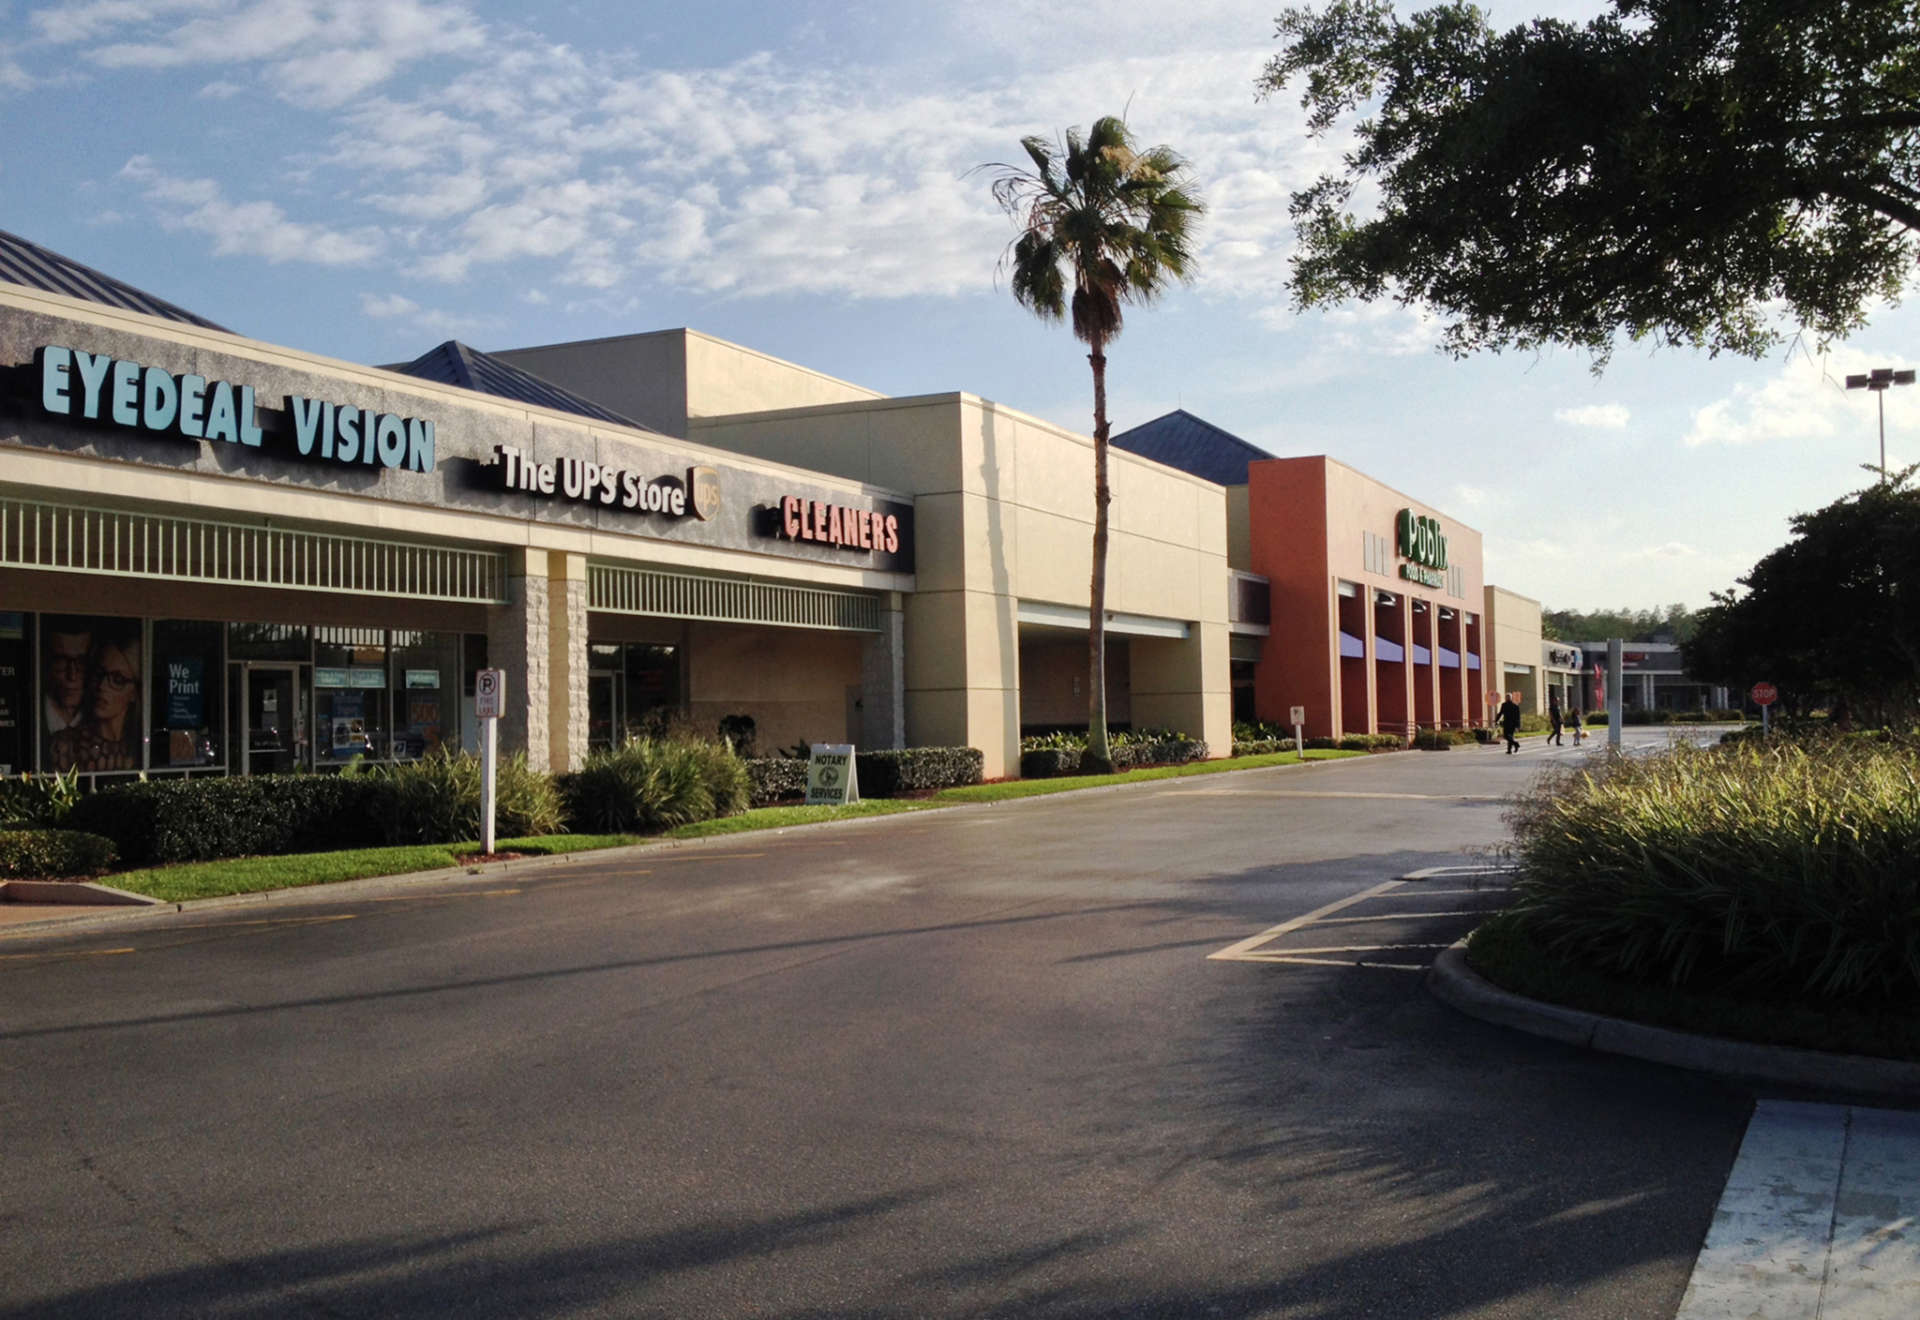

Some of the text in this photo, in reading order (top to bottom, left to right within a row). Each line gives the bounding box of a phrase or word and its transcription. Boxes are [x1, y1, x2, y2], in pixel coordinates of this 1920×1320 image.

[42, 345, 436, 473] EYEDEAL VISION
[501, 445, 686, 516] The UPS Store
[783, 496, 899, 553] CLEANERS
[168, 663, 190, 679] We
[168, 680, 200, 694] Print
[1753, 688, 1776, 699] STOP
[815, 754, 848, 766] NOTARY
[810, 787, 844, 799] SERVICES
